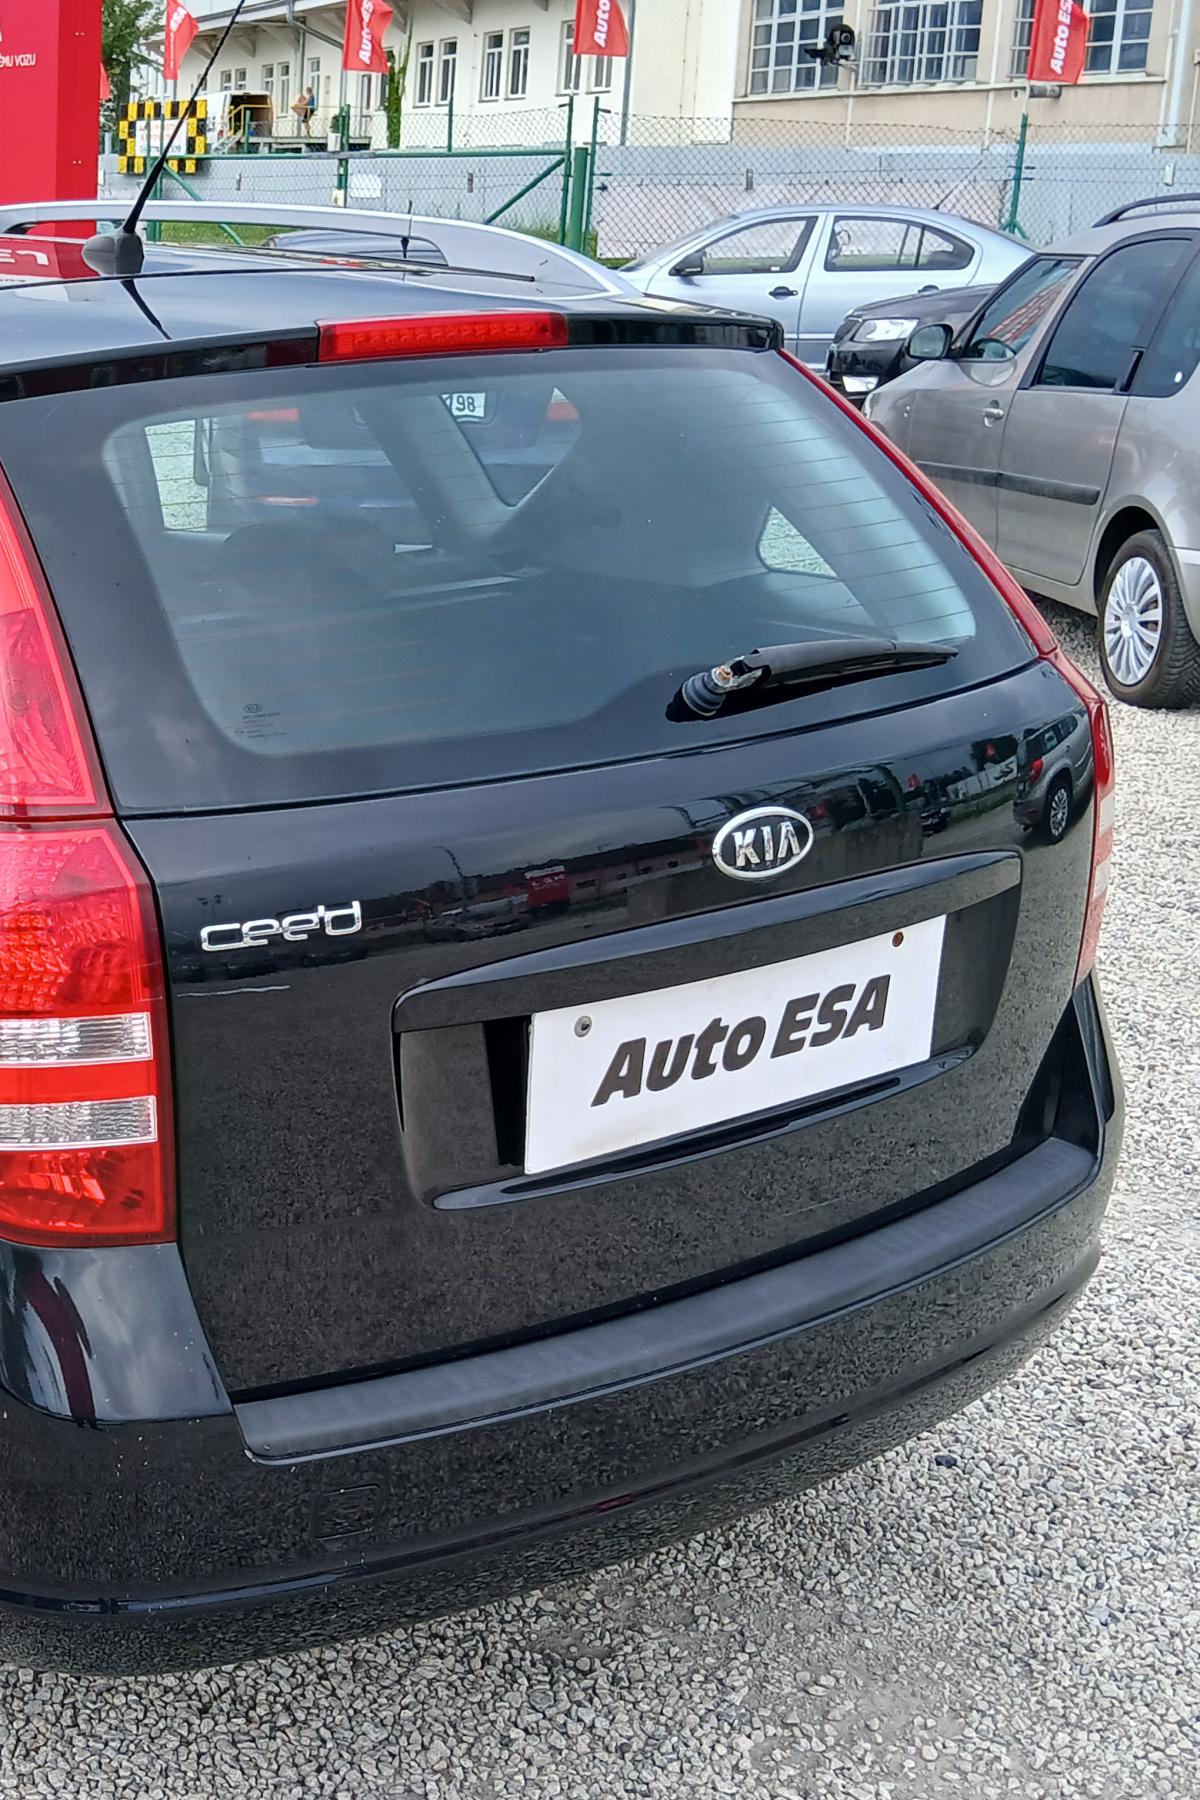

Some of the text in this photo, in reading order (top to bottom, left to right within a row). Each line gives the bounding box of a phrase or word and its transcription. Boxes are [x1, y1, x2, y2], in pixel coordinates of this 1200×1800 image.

[594, 0, 610, 48] Auto
[14, 53, 37, 67] VOZU
[1050, 24, 1070, 75] Auto
[732, 821, 801, 867] KIA
[590, 974, 891, 1107] Auto ESA
